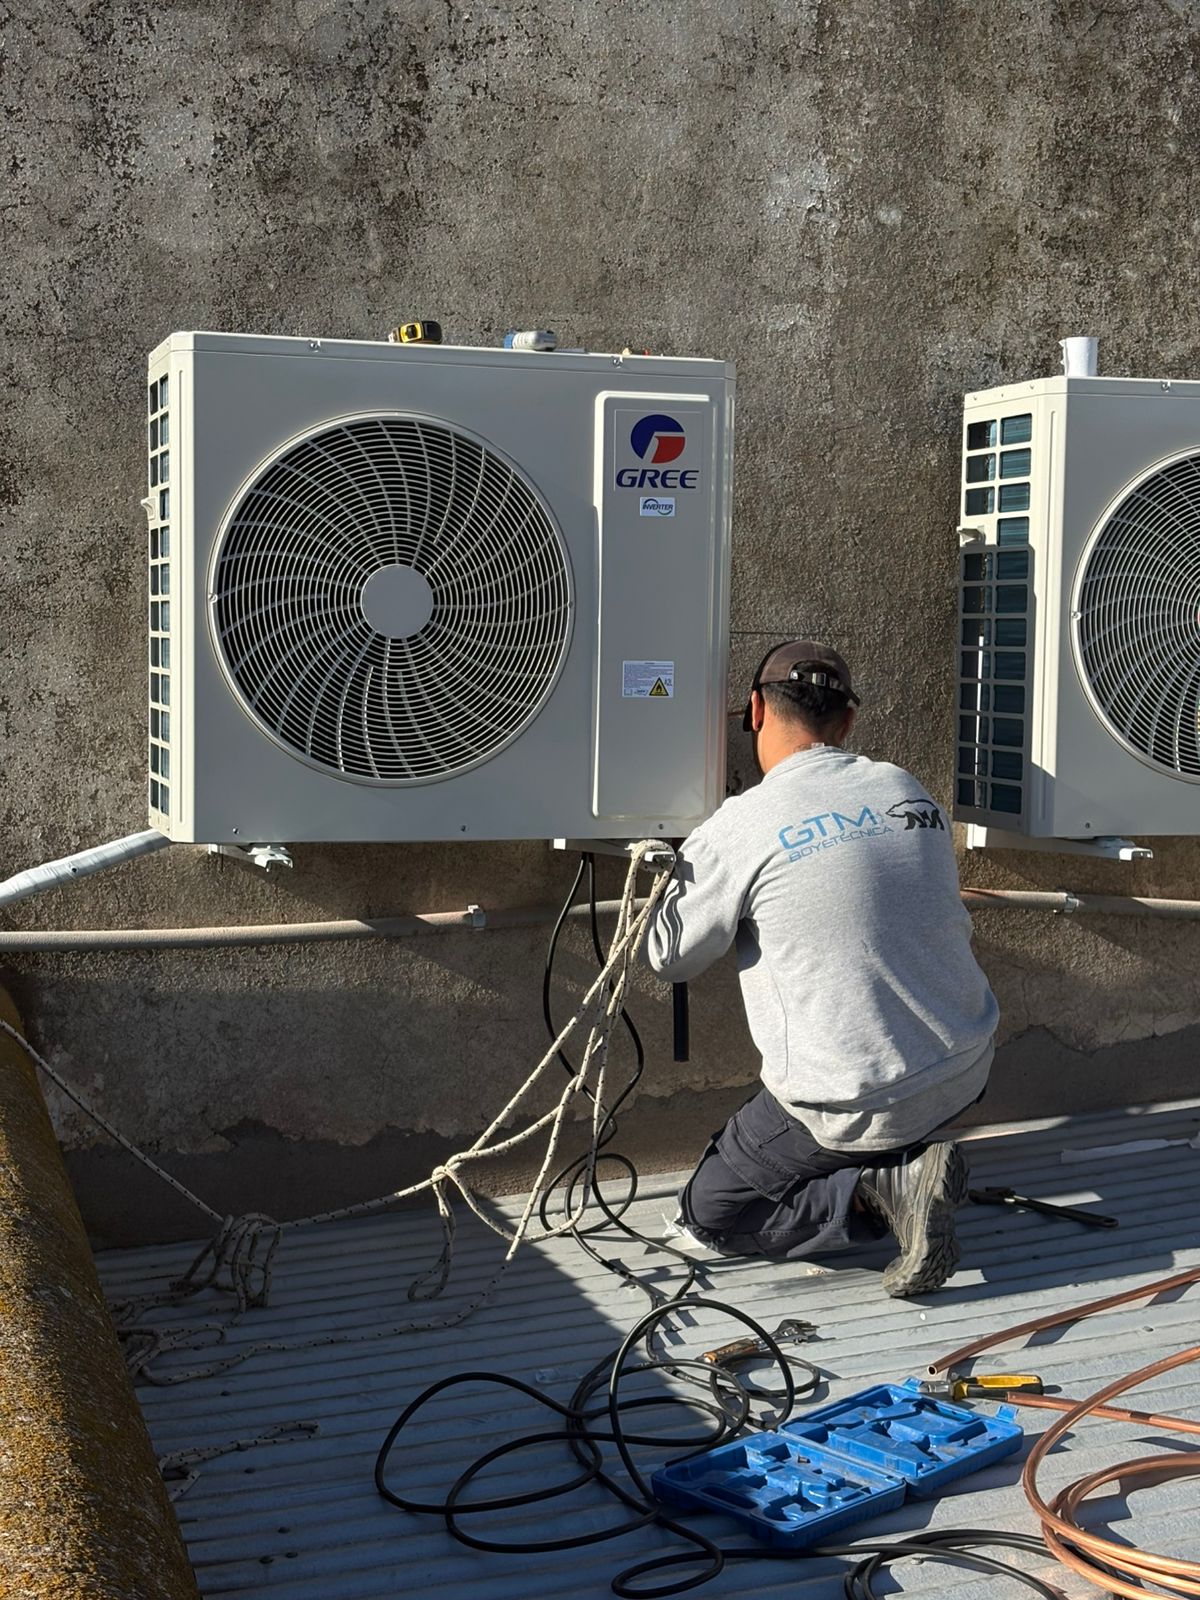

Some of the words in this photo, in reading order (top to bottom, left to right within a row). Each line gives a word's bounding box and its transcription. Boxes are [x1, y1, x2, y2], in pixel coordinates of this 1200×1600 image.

[616, 468, 699, 489] GREE
[642, 503, 674, 511] INVERTER
[778, 806, 877, 849] GTM
